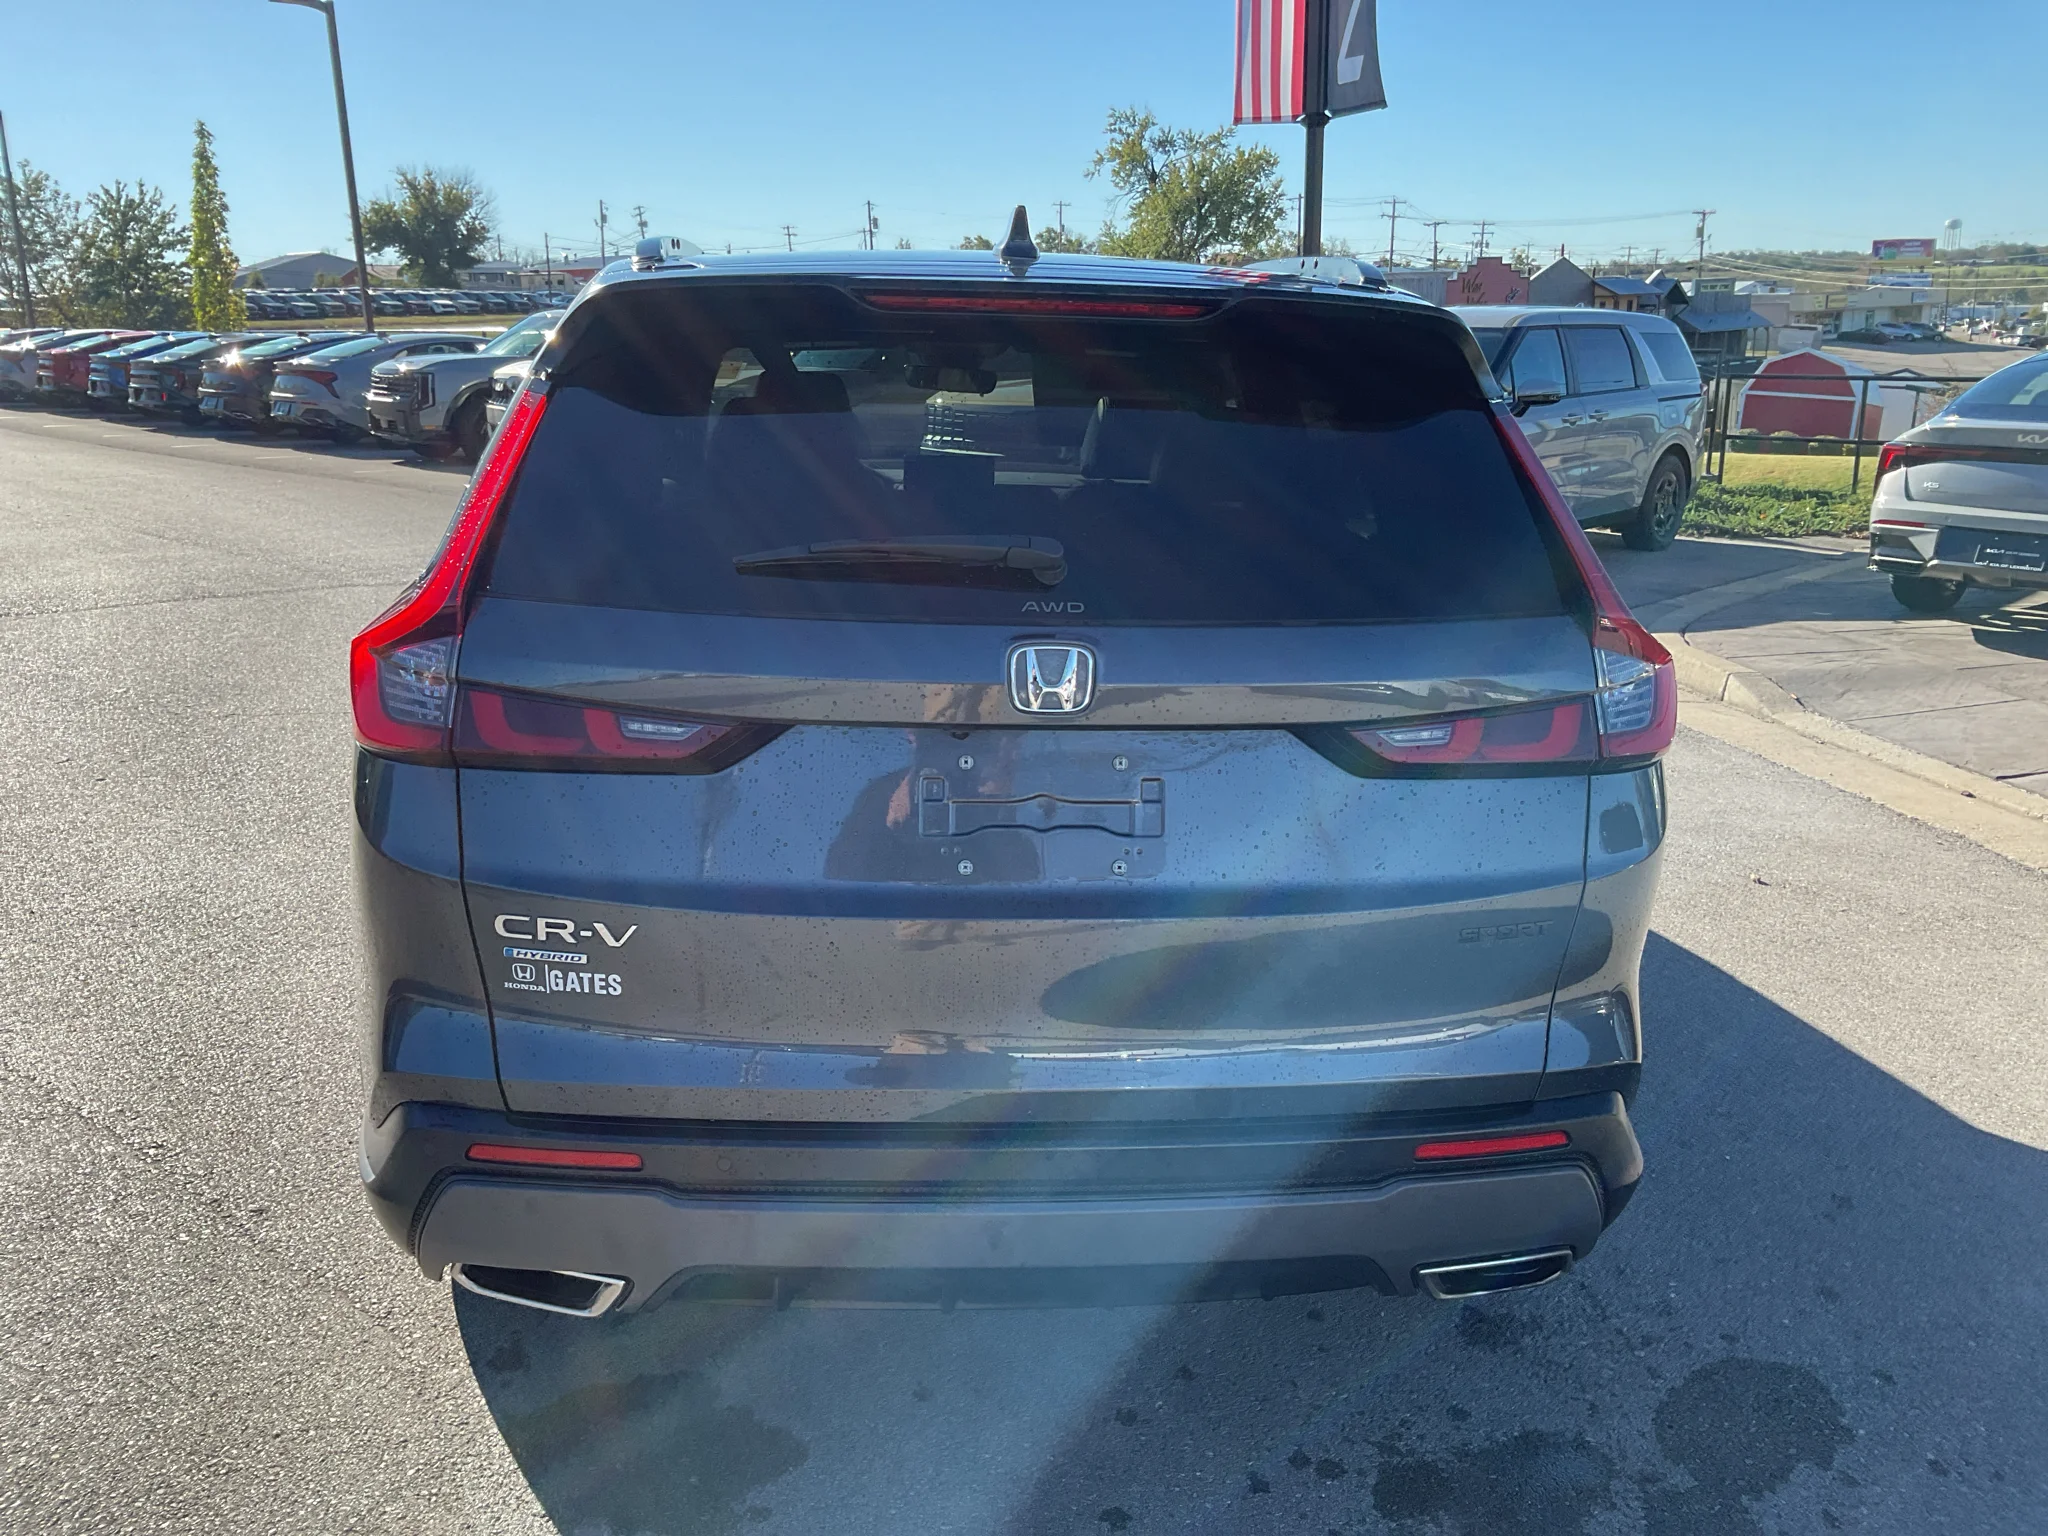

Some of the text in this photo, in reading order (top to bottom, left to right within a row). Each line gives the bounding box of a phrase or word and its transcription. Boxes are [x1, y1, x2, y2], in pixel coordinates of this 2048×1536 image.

[1924, 481, 1940, 489] K5
[1021, 601, 1085, 613] AWD
[494, 914, 639, 948] CR-V
[1458, 919, 1555, 943] SPORT
[515, 949, 582, 963] HYBRID
[504, 969, 622, 996] HONDA GATES
